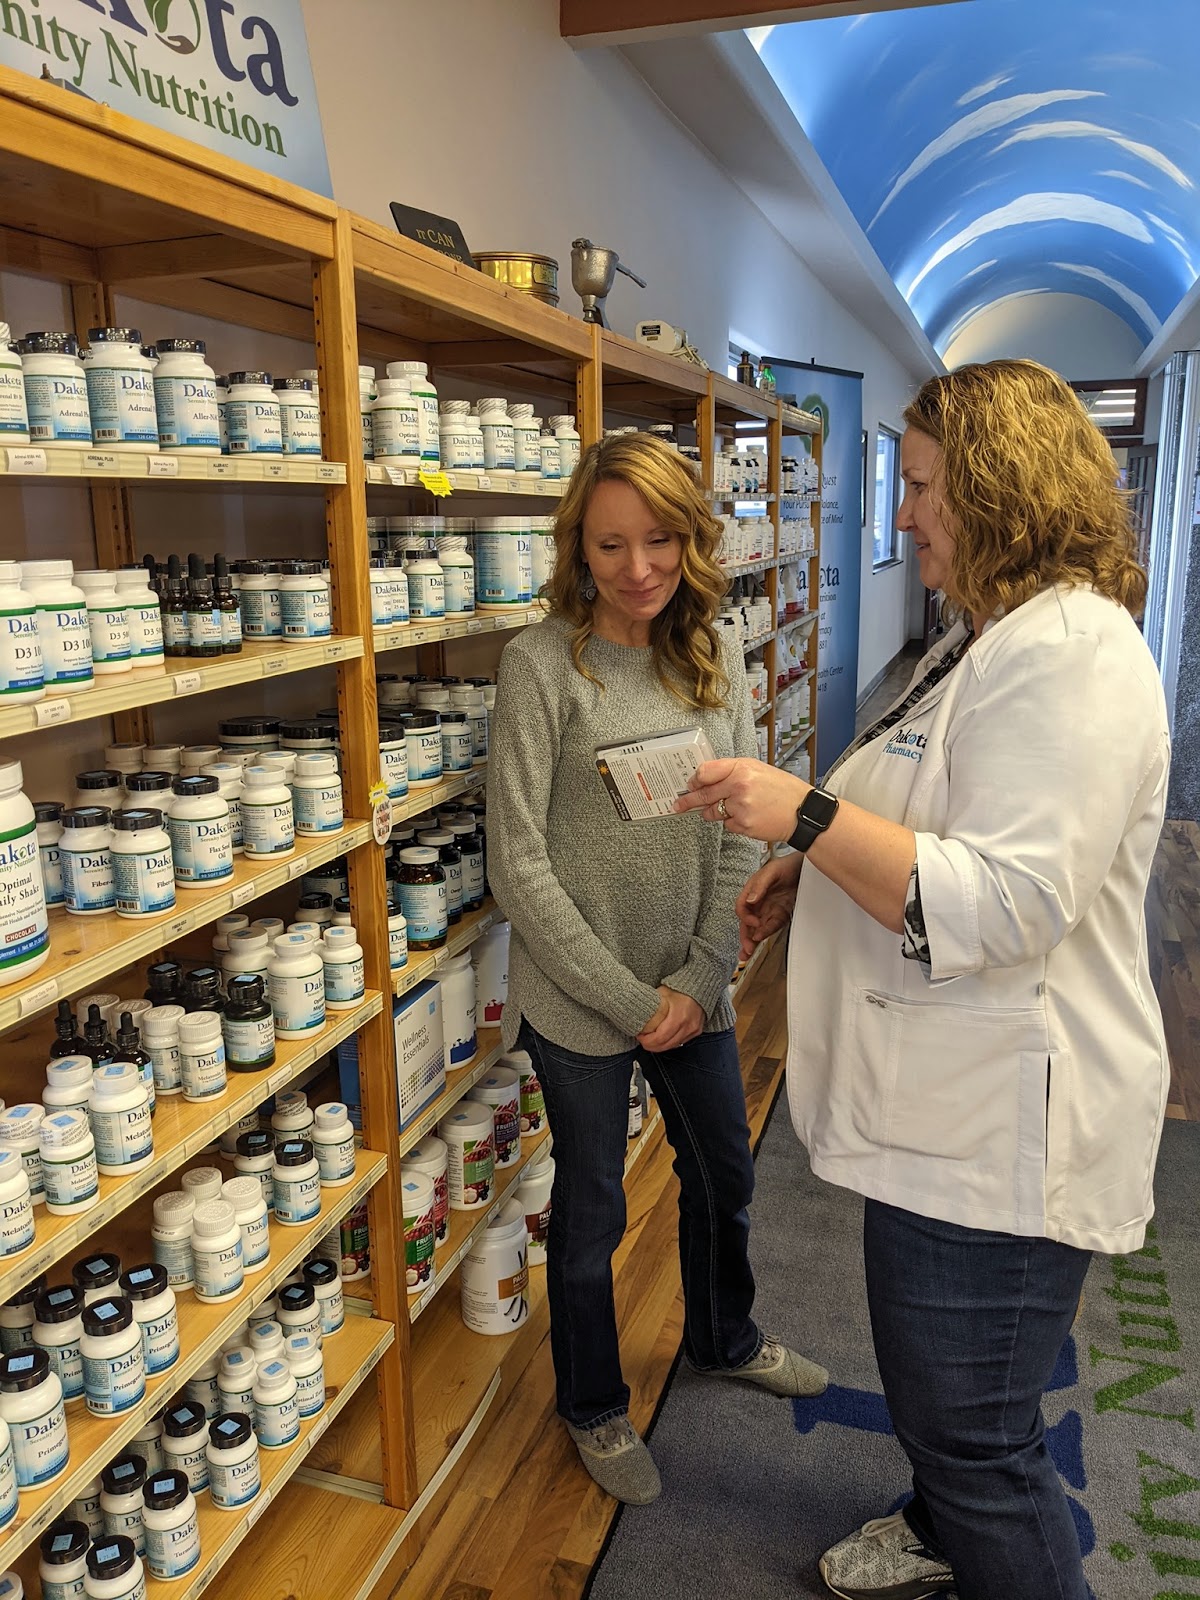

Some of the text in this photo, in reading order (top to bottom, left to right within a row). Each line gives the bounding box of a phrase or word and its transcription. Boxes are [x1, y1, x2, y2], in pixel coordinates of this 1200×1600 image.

[79, 0, 298, 107] ota
[2, 0, 287, 157] nity Nutrition
[427, 229, 455, 248] CAN
[59, 410, 83, 418] Adrenal
[128, 404, 152, 412] Adrenal
[15, 647, 32, 659] D3
[63, 641, 79, 651] D3
[883, 742, 923, 763] Pharmacy
[0, 842, 36, 865] akota
[209, 846, 221, 854] Flax
[218, 852, 226, 860] Oil
[0, 863, 12, 873] nity
[0, 872, 32, 894] Optimal
[0, 884, 40, 906] ily Shake
[10, 916, 23, 925] Health
[6, 924, 36, 942] CHOCOLATE
[402, 1024, 427, 1051] Wellness
[403, 1034, 430, 1064] Essentials
[197, 1057, 217, 1068] Dak
[219, 1250, 236, 1262] Dak
